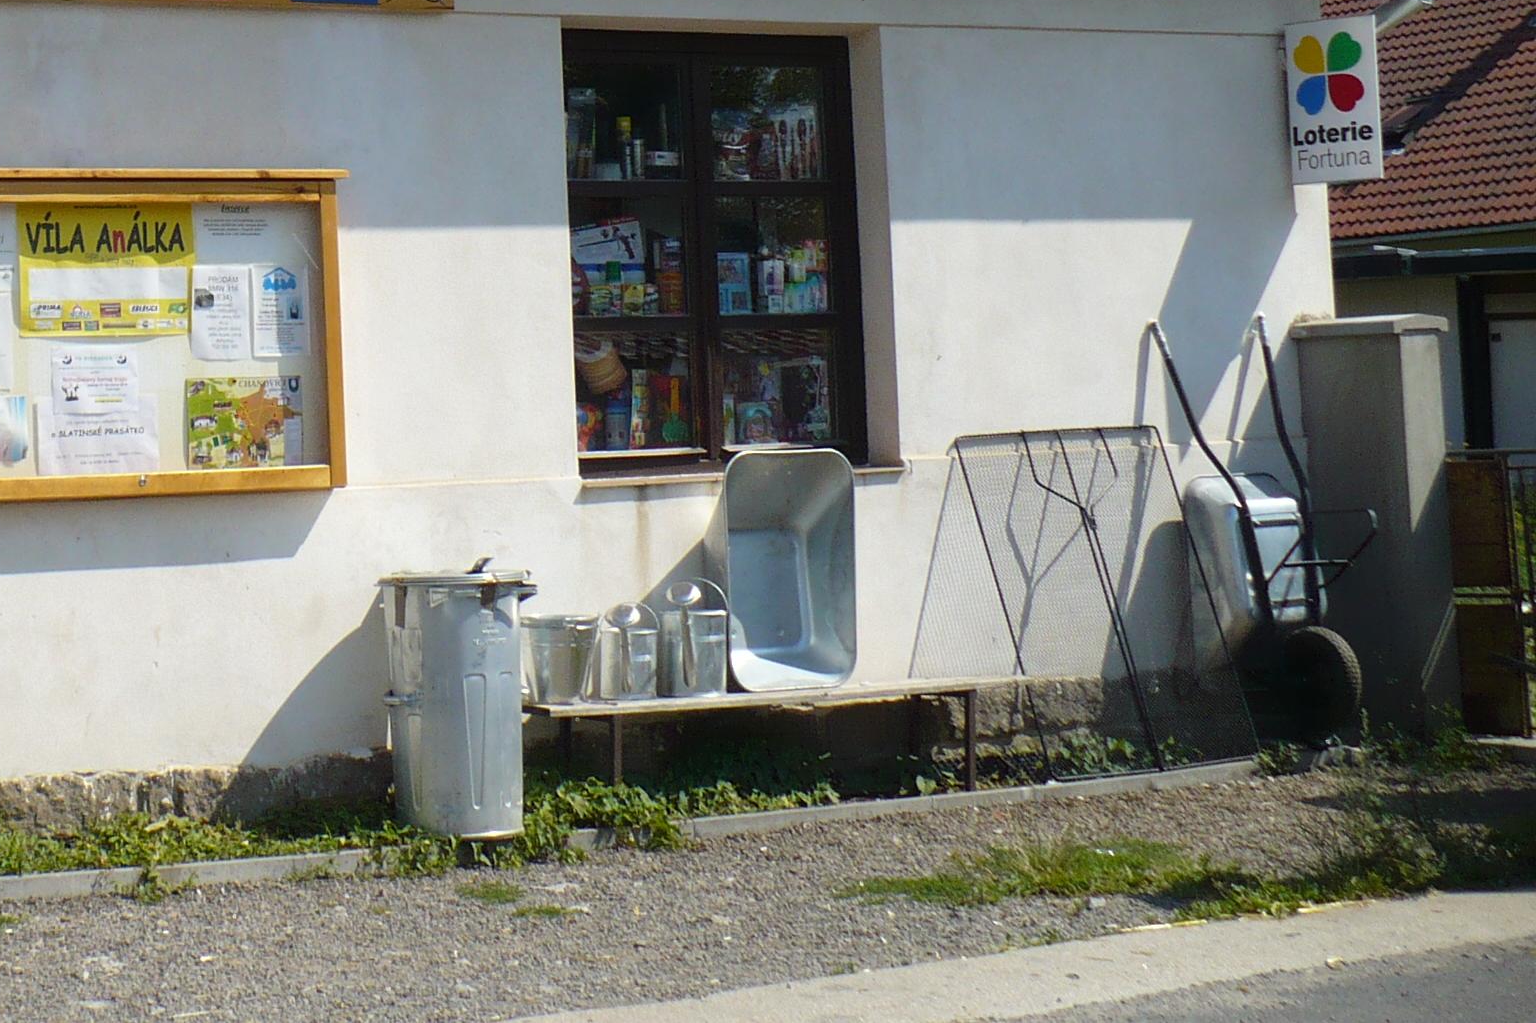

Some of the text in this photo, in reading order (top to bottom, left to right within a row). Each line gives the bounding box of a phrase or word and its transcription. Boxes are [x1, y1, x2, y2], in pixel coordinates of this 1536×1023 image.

[1293, 122, 1373, 146] Loterie
[1297, 149, 1371, 170] Fortuna
[25, 211, 85, 254] VÍLA
[96, 210, 185, 254] AnÁLKA
